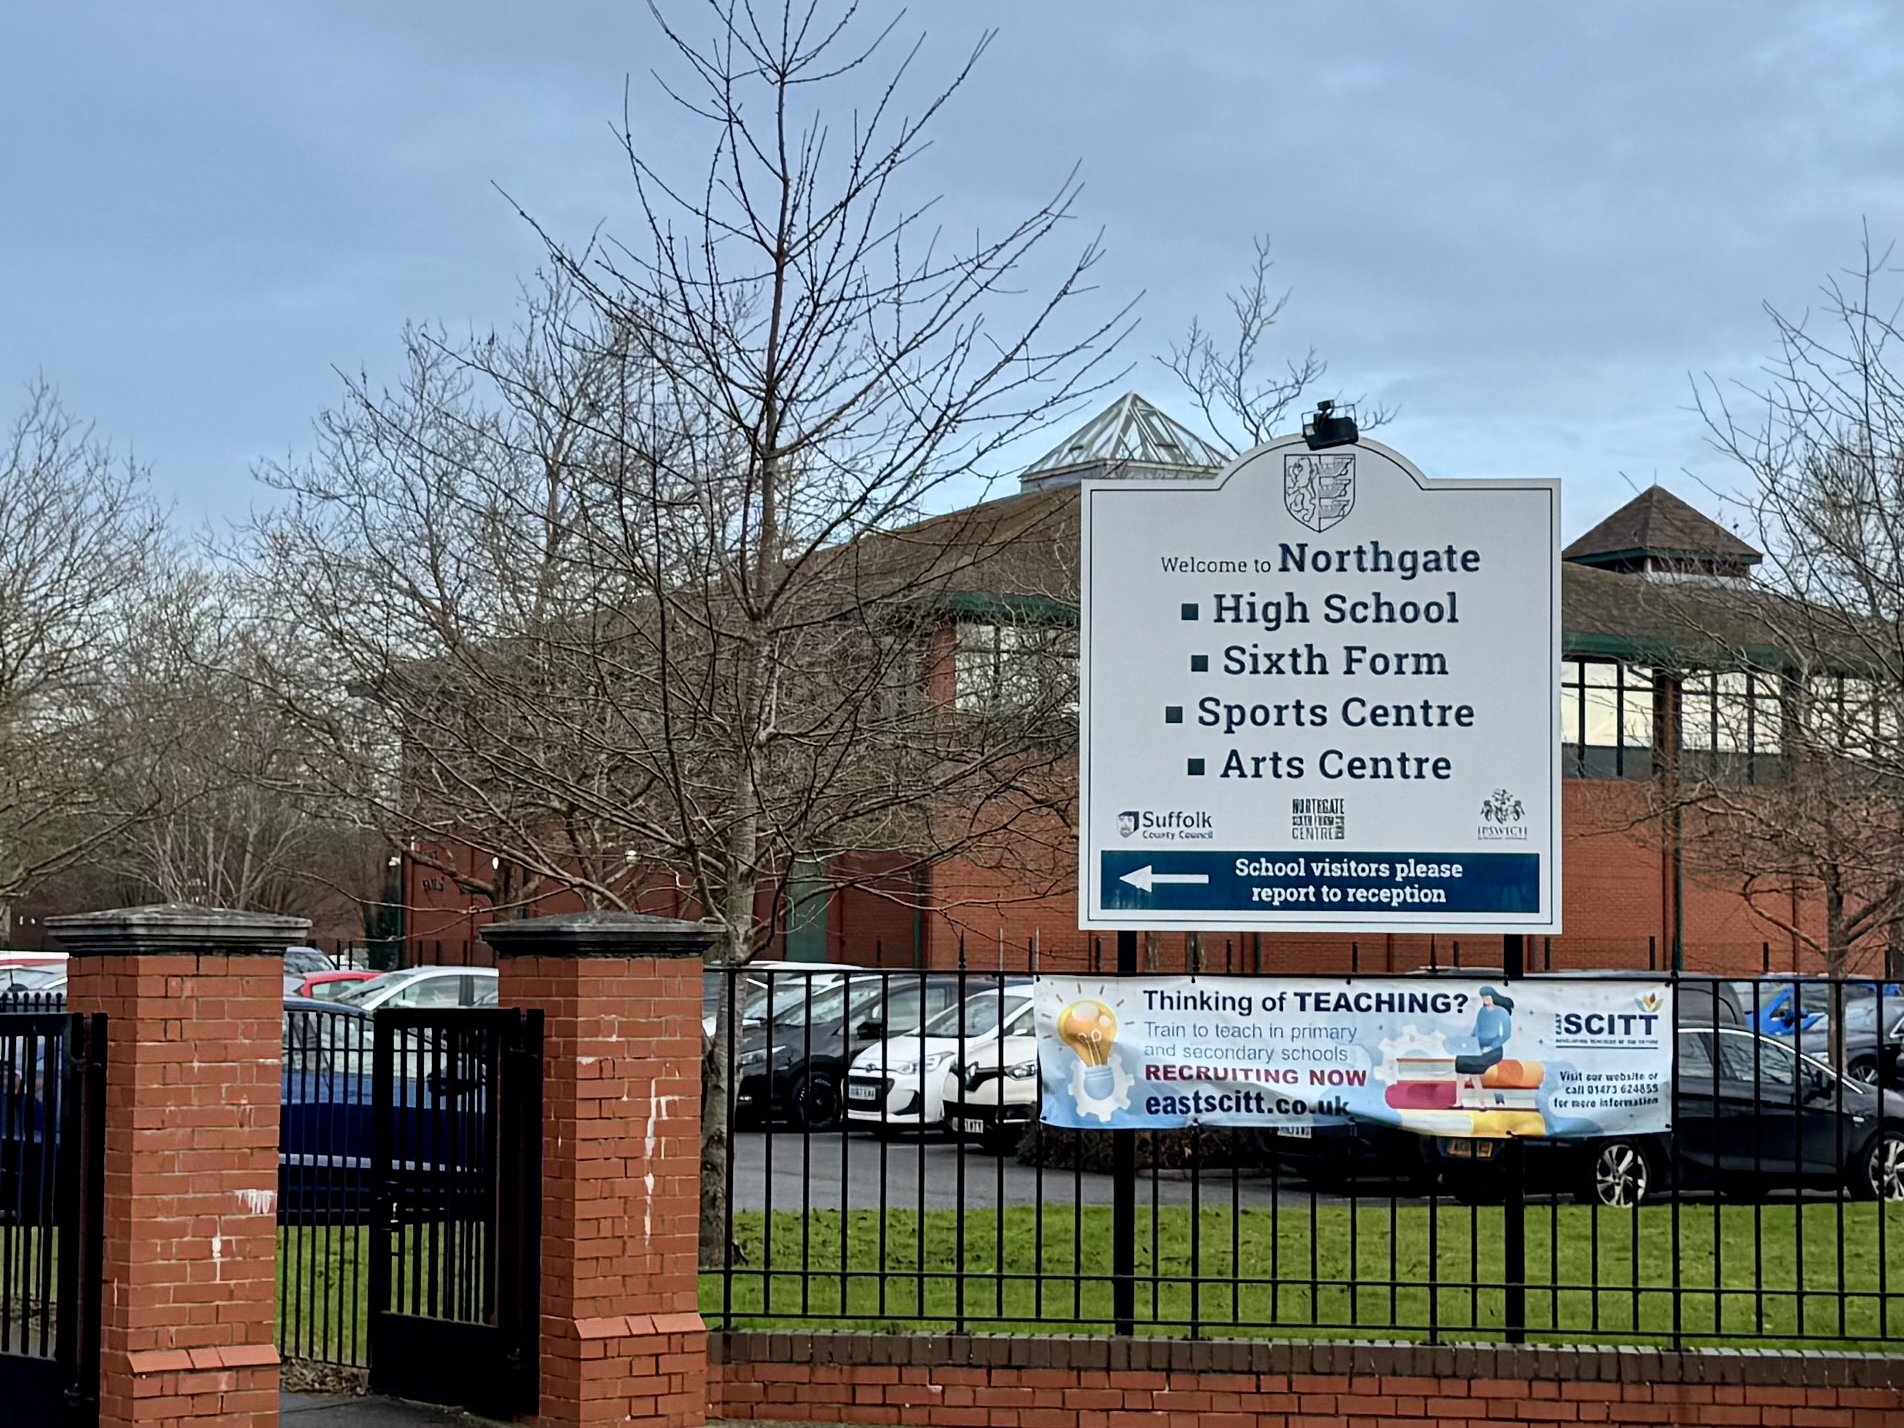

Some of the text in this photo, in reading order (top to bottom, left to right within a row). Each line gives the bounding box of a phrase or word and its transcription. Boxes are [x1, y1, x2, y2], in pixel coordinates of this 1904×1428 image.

[1161, 541, 1481, 580] Welcome to Northgate
[1213, 592, 1460, 631] High School
[1223, 644, 1449, 675] Sixth Form
[1197, 698, 1475, 734] Sports Centre
[1219, 750, 1452, 780] Arts Centre
[1143, 811, 1213, 828] Suffolk
[1235, 859, 1463, 882] School visitors please
[1251, 886, 1446, 908] report to reception
[1143, 990, 1469, 1016] Thinking of TEACHING?
[1144, 1022, 1358, 1042] Train to teach in primary
[1564, 1013, 1658, 1035] SCITT
[1144, 1044, 1348, 1064] and secondary schools
[1146, 1065, 1367, 1086] RECRUITING NOW
[1560, 1071, 1582, 1081] Visit
[1565, 1085, 1584, 1095] call
[1146, 1090, 1350, 1116] eastscitt.co.uk
